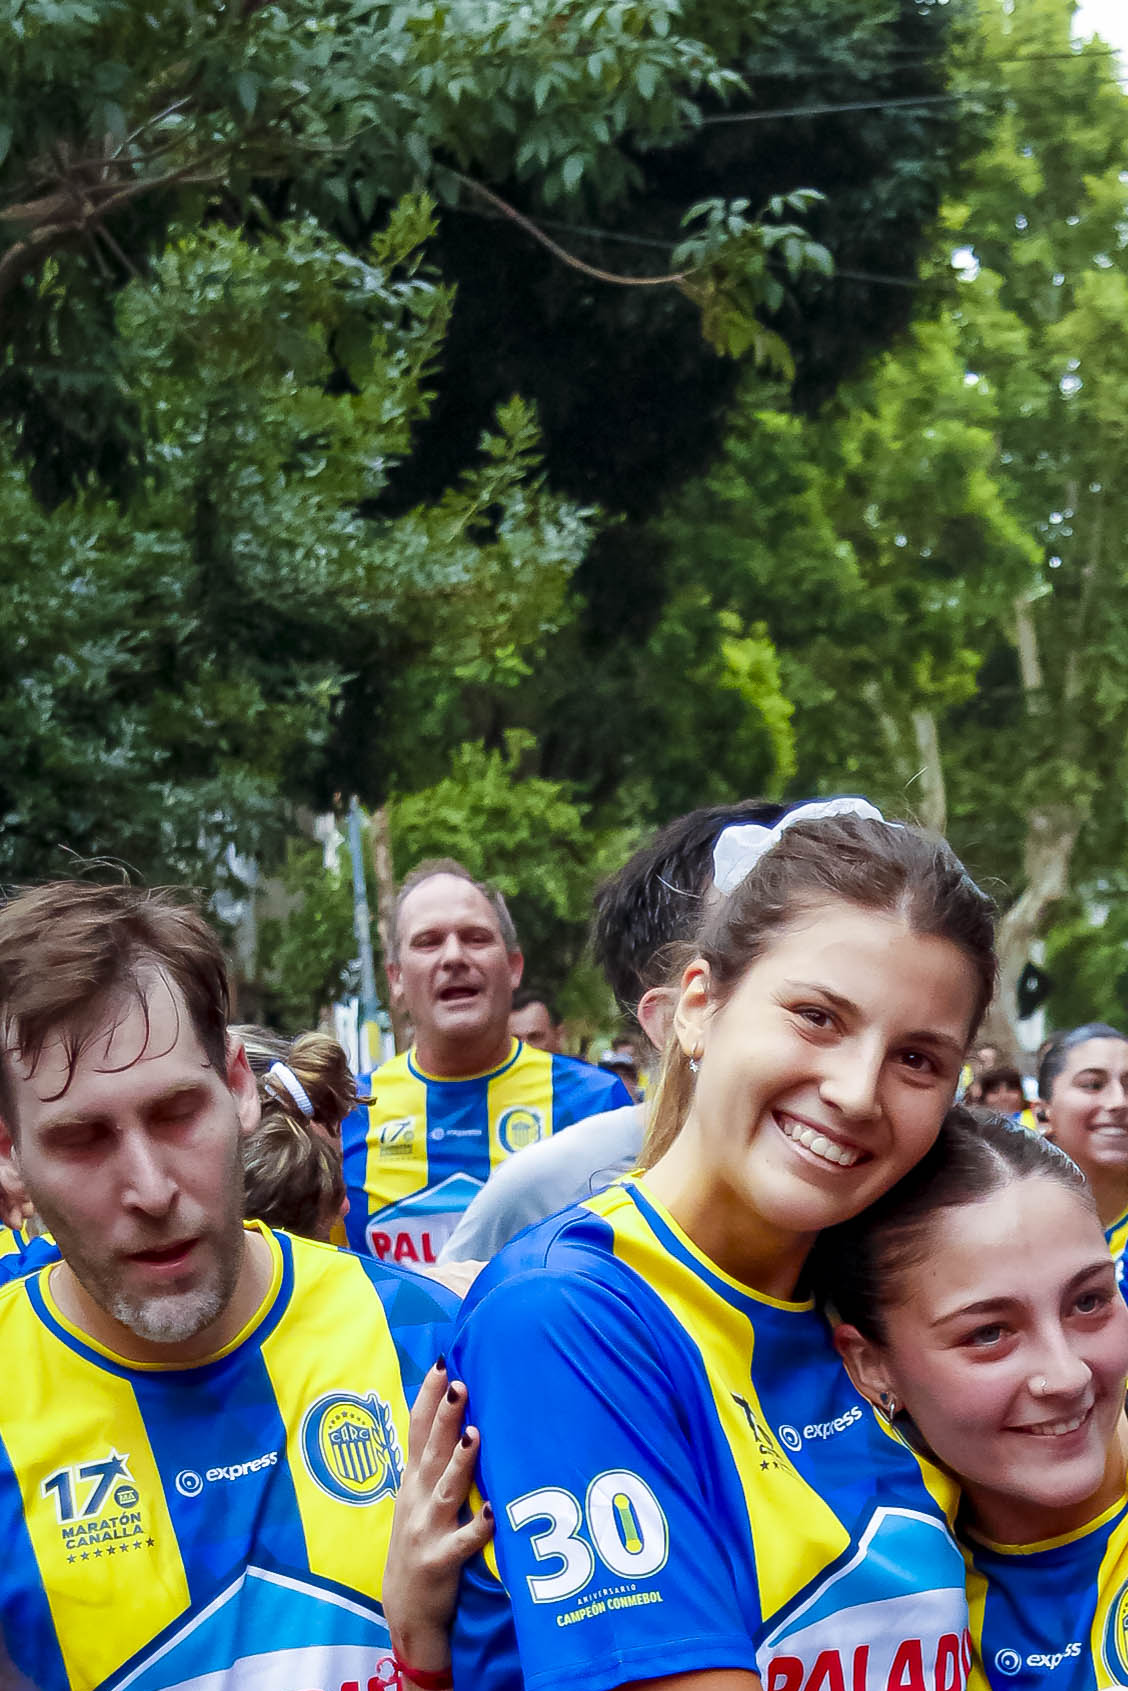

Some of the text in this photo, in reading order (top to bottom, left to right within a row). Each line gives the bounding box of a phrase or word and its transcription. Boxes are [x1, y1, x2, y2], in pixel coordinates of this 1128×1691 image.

[371, 1231, 437, 1263] PAL
[803, 1405, 863, 1440] express
[206, 1451, 279, 1481] express
[42, 1450, 132, 1524] 17
[62, 1511, 142, 1540] MARATÓN
[66, 1525, 143, 1550] CANALLA
[506, 1469, 669, 1604] 30
[556, 1591, 664, 1627] CAMPEÓN CONMEBOL
[577, 1583, 637, 1606] ANIVERSARIO
